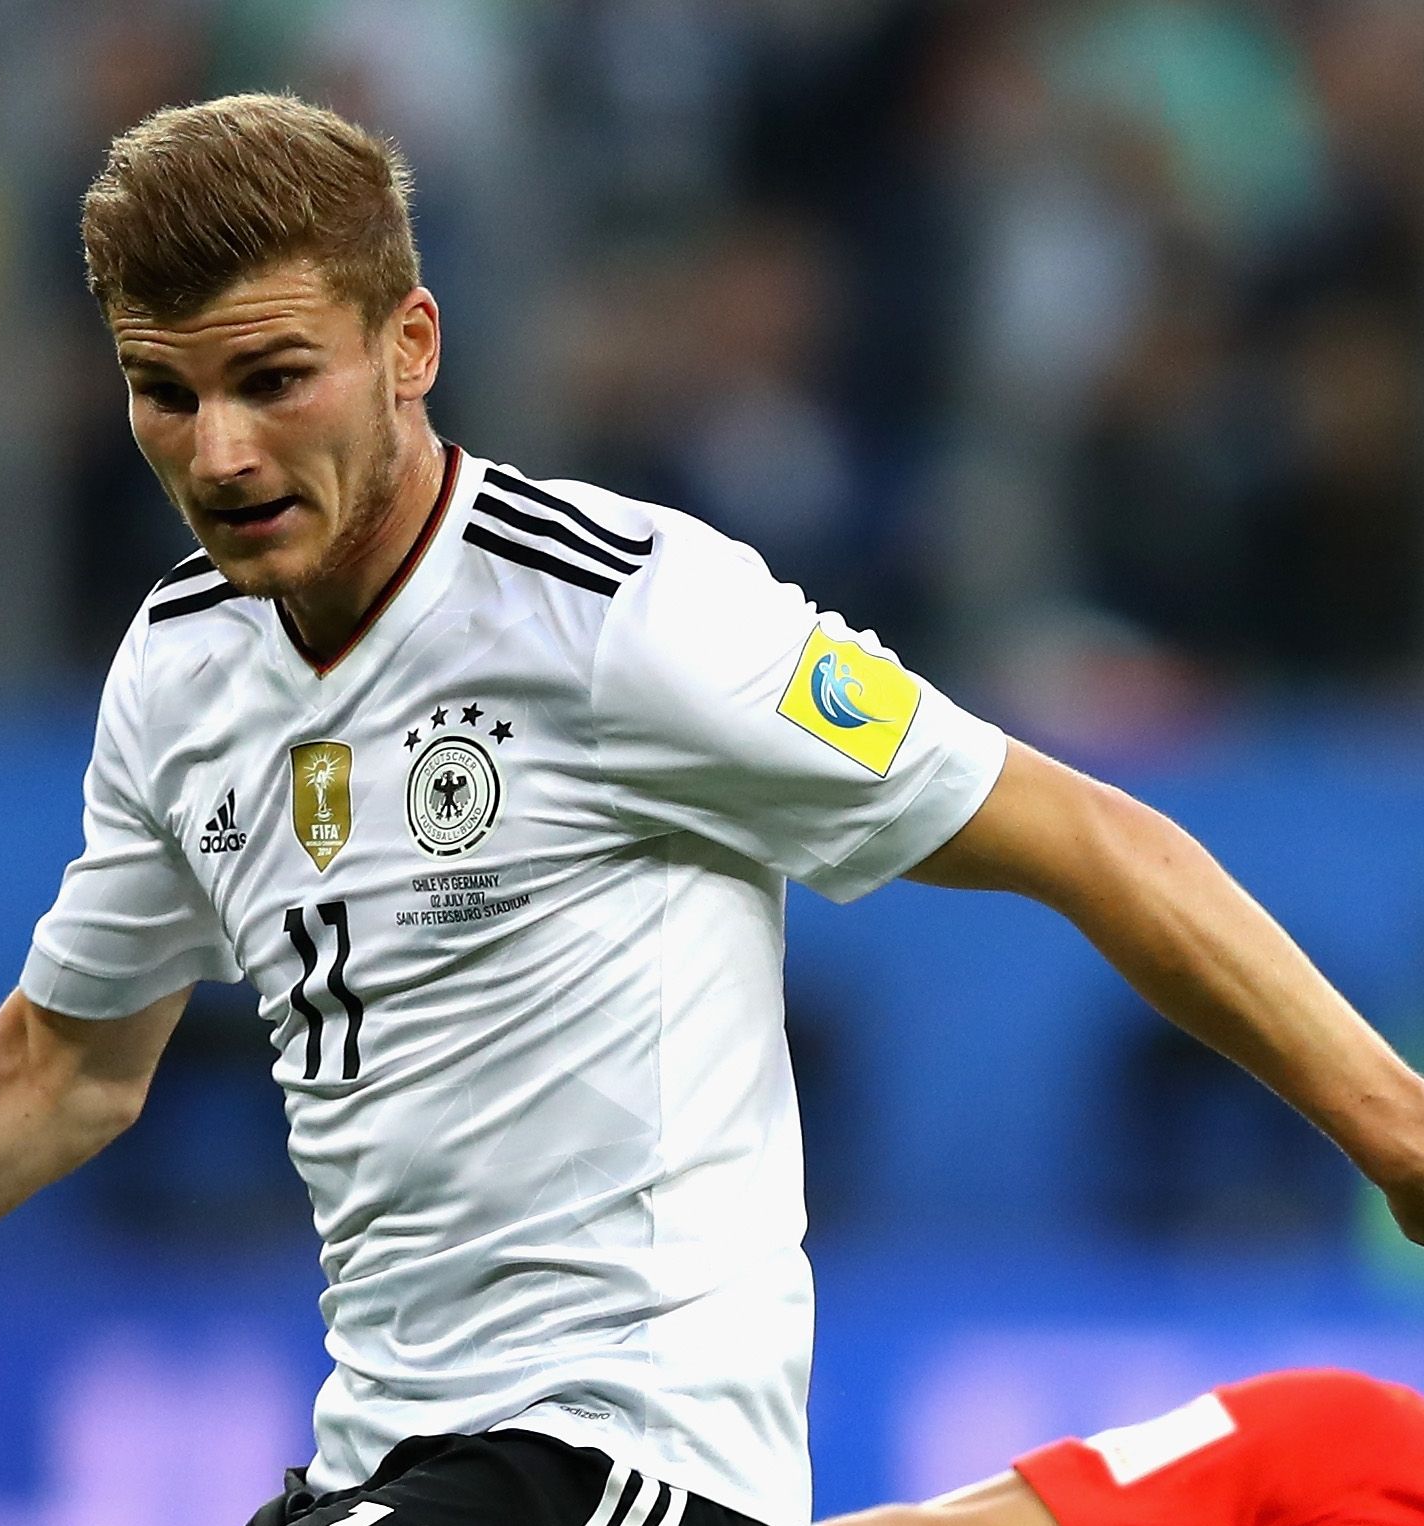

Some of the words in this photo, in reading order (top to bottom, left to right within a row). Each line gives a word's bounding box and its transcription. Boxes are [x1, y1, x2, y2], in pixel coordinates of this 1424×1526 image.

[423, 752, 478, 778] DEUTSCHER
[311, 824, 339, 840] FIFA
[412, 878, 437, 892] CHILE
[437, 877, 449, 891] VS
[451, 874, 499, 890] GERMANY
[430, 894, 441, 908] 02
[442, 892, 464, 908] JULY
[466, 891, 485, 906] 2017
[396, 911, 419, 926] SAINT
[420, 907, 482, 926] PETERSBURG
[483, 894, 531, 918] STADIUM
[283, 901, 364, 1080] 11
[559, 1405, 611, 1420] adizero
